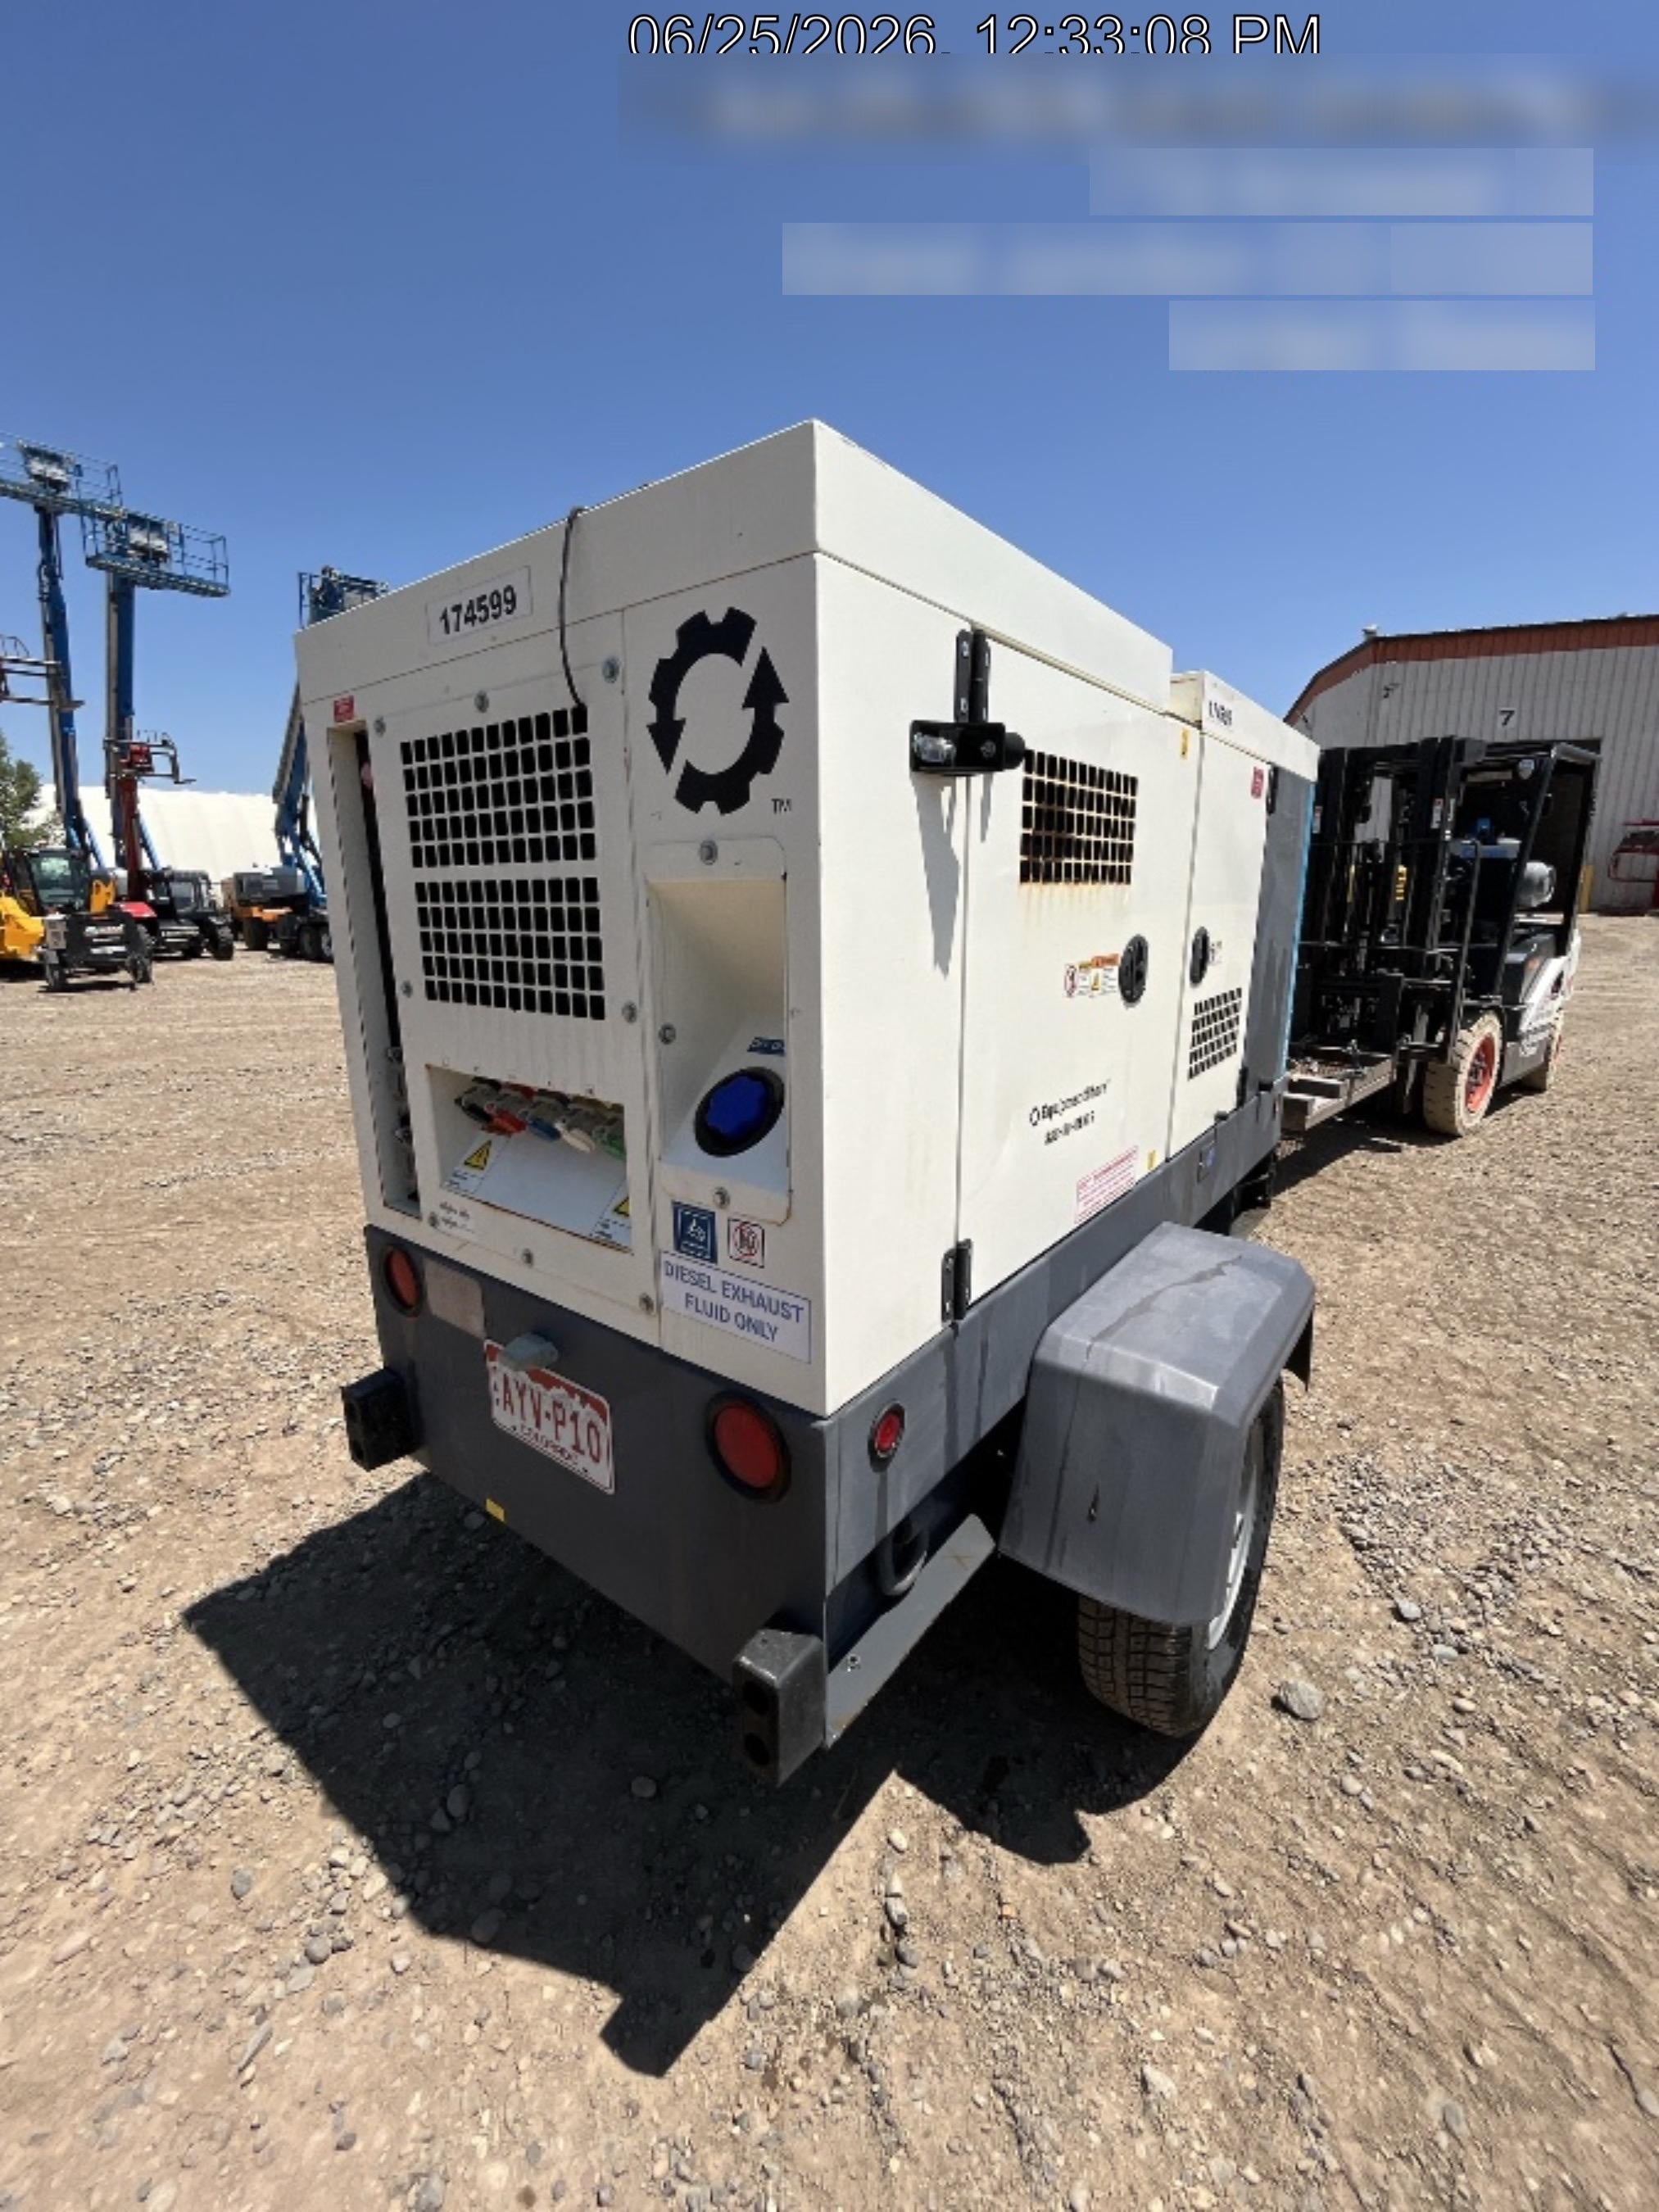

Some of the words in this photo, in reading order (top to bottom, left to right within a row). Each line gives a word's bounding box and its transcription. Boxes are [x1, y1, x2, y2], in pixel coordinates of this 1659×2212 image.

[439, 584, 517, 635] 174599
[1498, 710, 1516, 727] 7
[771, 798, 793, 814] TM
[664, 1261, 718, 1294] DIESEL
[721, 1280, 805, 1324] EXHAUST
[685, 1292, 732, 1324] FLUID
[734, 1311, 779, 1342] ONLY
